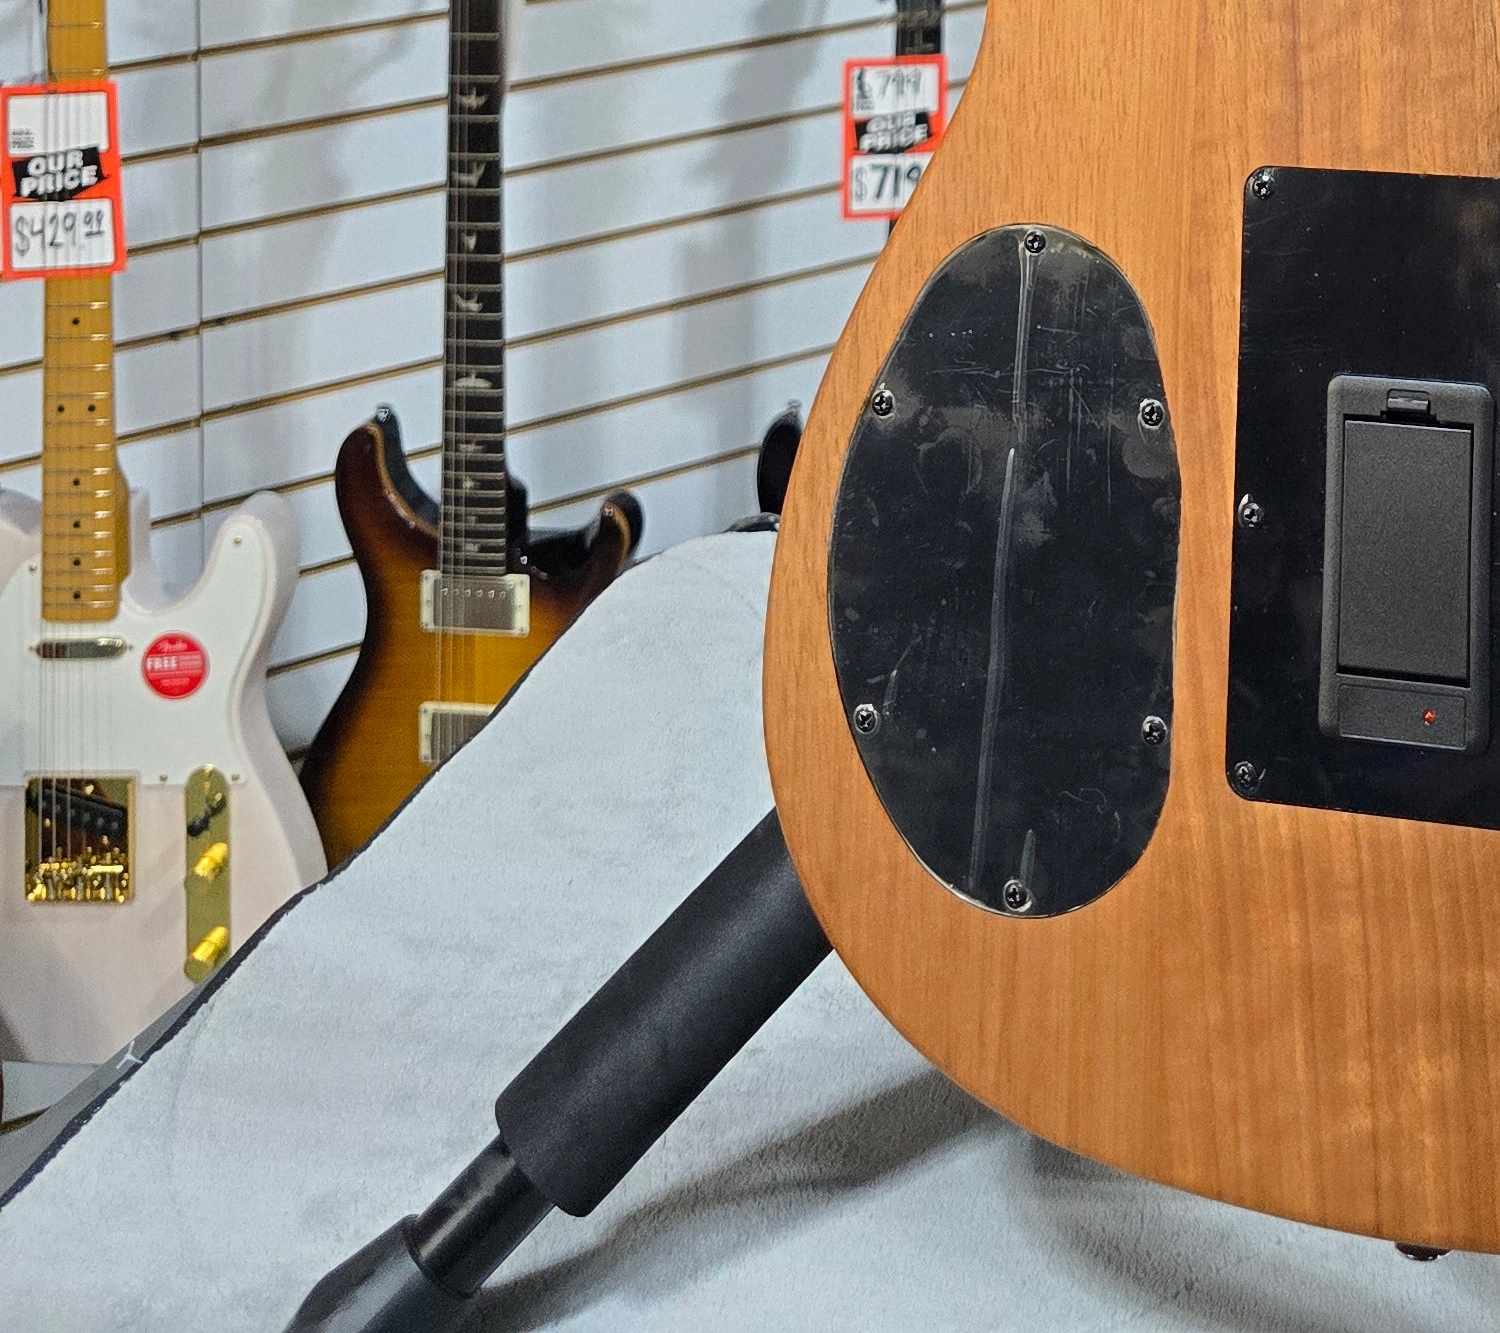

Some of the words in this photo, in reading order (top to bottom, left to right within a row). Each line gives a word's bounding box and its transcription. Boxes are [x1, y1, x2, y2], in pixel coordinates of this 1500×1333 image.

[27, 150, 84, 176] OUR
[20, 164, 98, 198] PRICE
[146, 656, 178, 672] FREE
